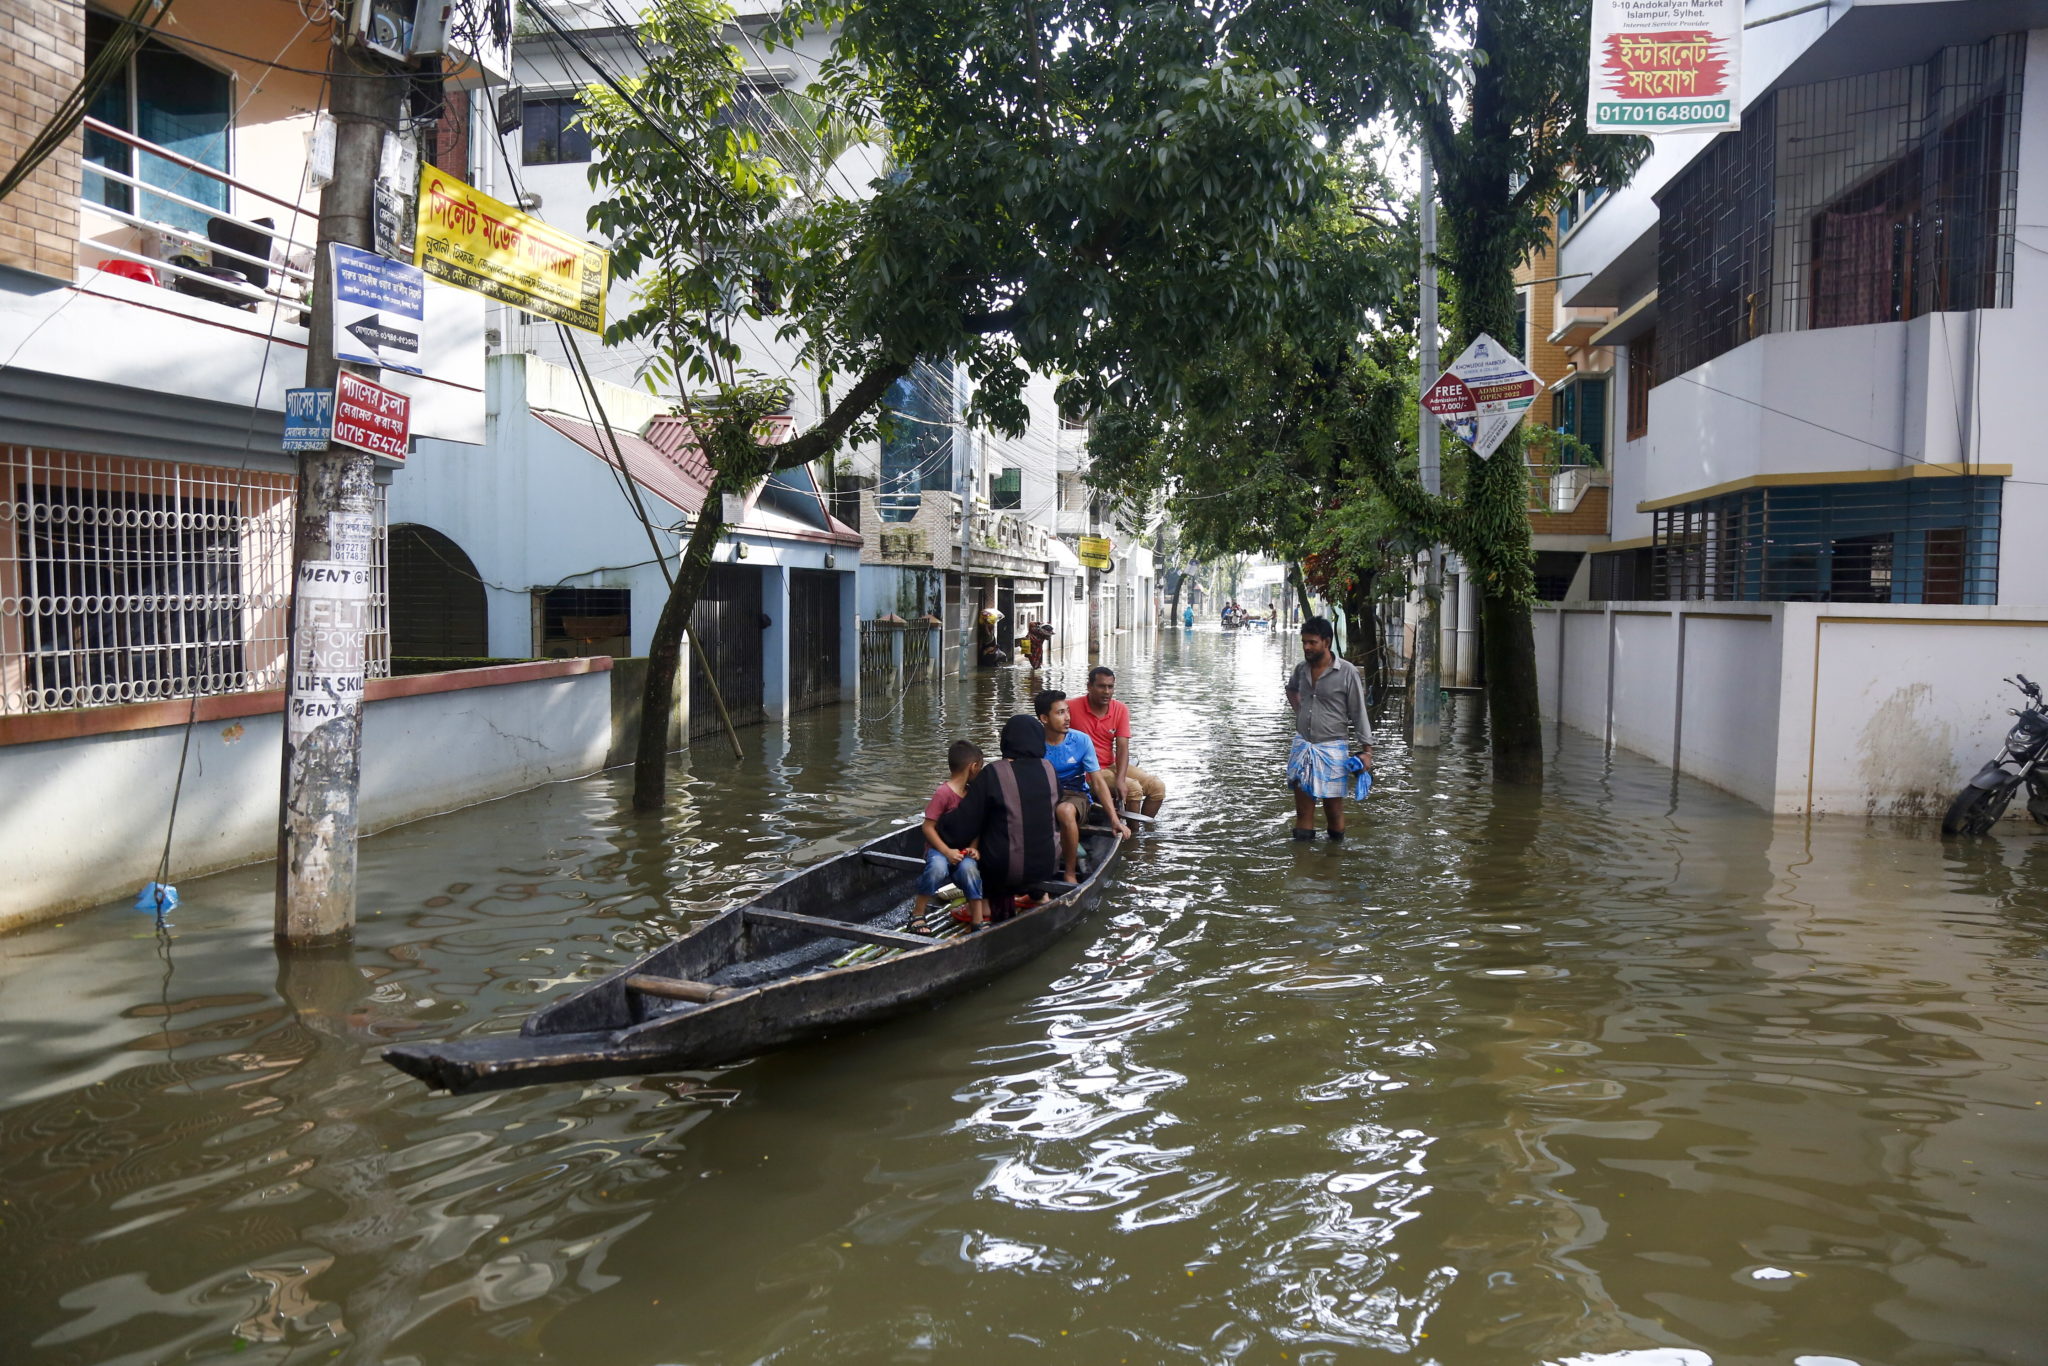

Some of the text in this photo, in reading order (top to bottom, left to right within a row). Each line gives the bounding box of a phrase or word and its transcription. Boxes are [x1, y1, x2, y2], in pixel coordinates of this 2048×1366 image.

[1691, 0, 1723, 8] Market
[1627, 8, 1705, 19] Islampur, Sylhet.
[1619, 34, 1709, 68] ইন্টারনেট
[1628, 68, 1699, 96] সংযোগ
[1600, 104, 1726, 121] 01701648000
[428, 178, 479, 237] সিলেট
[481, 212, 524, 258] মডেল
[342, 376, 407, 417] গ্যাসের চুলা
[1435, 384, 1463, 397] FREE
[1477, 383, 1522, 395] ADMISSION
[1480, 392, 1503, 401] OPEN
[287, 391, 333, 424] গ্যাসের চুলা
[340, 402, 373, 422] মেরামত
[284, 427, 308, 438] মেরামত
[308, 427, 321, 438] করা
[337, 421, 364, 443] 01715
[335, 542, 359, 551] 01727
[335, 551, 359, 560] 01748
